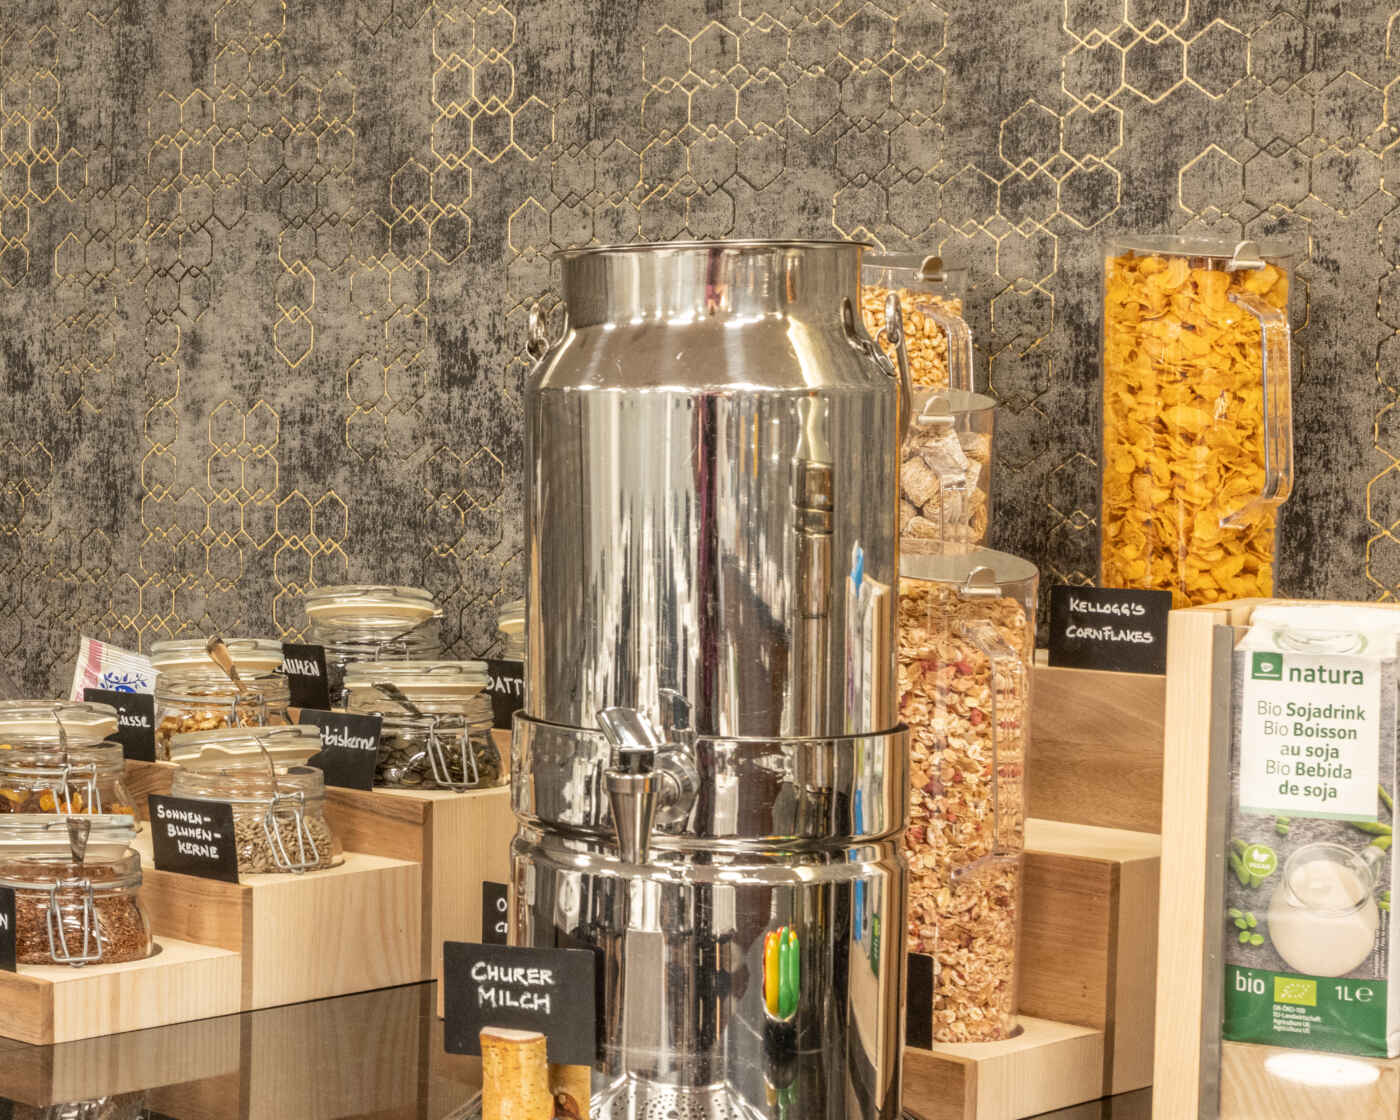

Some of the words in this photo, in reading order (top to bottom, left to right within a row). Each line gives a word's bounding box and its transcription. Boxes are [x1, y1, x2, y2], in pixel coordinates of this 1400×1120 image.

[1069, 596, 1146, 616] KELLOGG'S
[1065, 625, 1154, 644] CORNFLAKES
[486, 675, 523, 696] DATT
[1289, 665, 1365, 686] natura
[1257, 700, 1282, 717] Bio
[1286, 702, 1366, 721] Sojadrink
[320, 726, 377, 751] rbiskerne
[1263, 720, 1289, 737] Bio
[1293, 721, 1358, 740] Boisson
[1280, 744, 1301, 757] au
[1305, 743, 1340, 762] soja
[1265, 759, 1290, 776] Bio
[1295, 761, 1352, 779] Bebida
[1279, 780, 1300, 796] de
[1303, 782, 1338, 802] soja
[177, 840, 220, 859] KERNE
[471, 961, 556, 986] CHURER
[1235, 970, 1265, 995] bio
[478, 985, 551, 1014] MILCH
